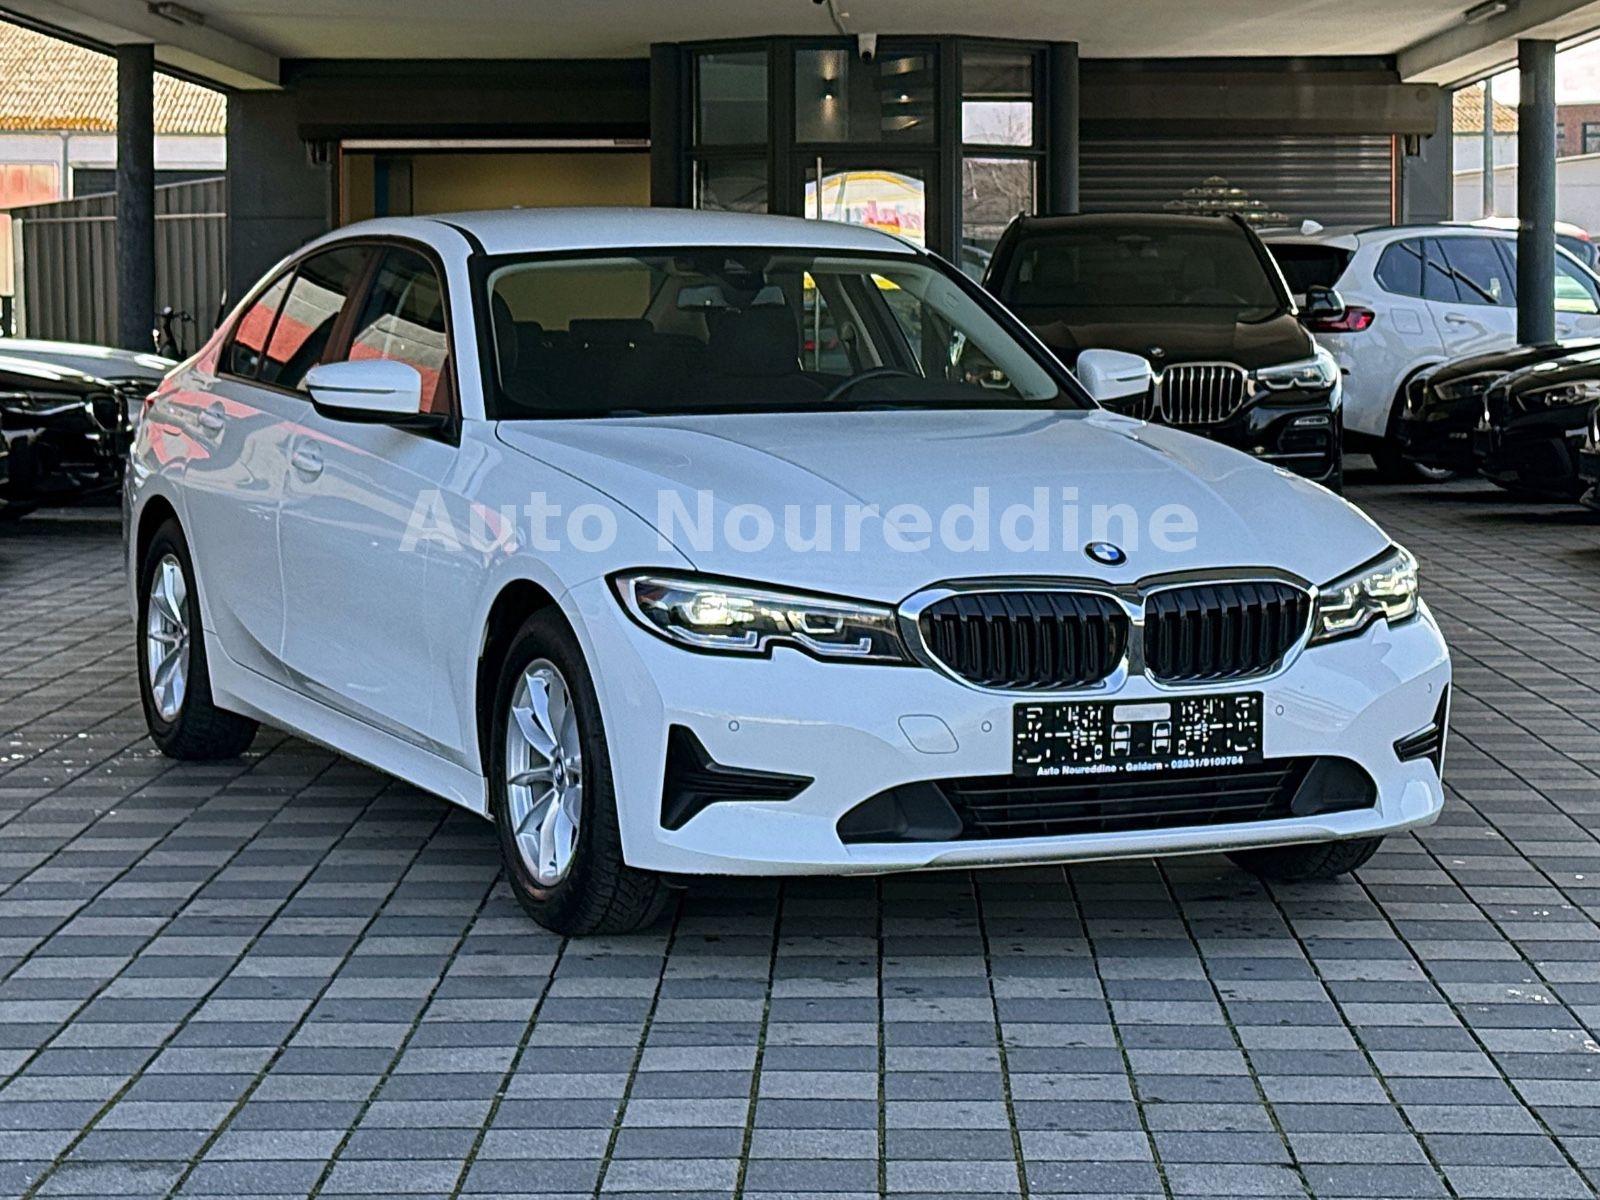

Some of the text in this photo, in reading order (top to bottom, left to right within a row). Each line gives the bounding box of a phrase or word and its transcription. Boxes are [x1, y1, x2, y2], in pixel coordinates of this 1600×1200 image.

[1036, 766, 1060, 776] Auto
[1062, 763, 1117, 775] Noureddine
[1125, 761, 1163, 772] Geldern
